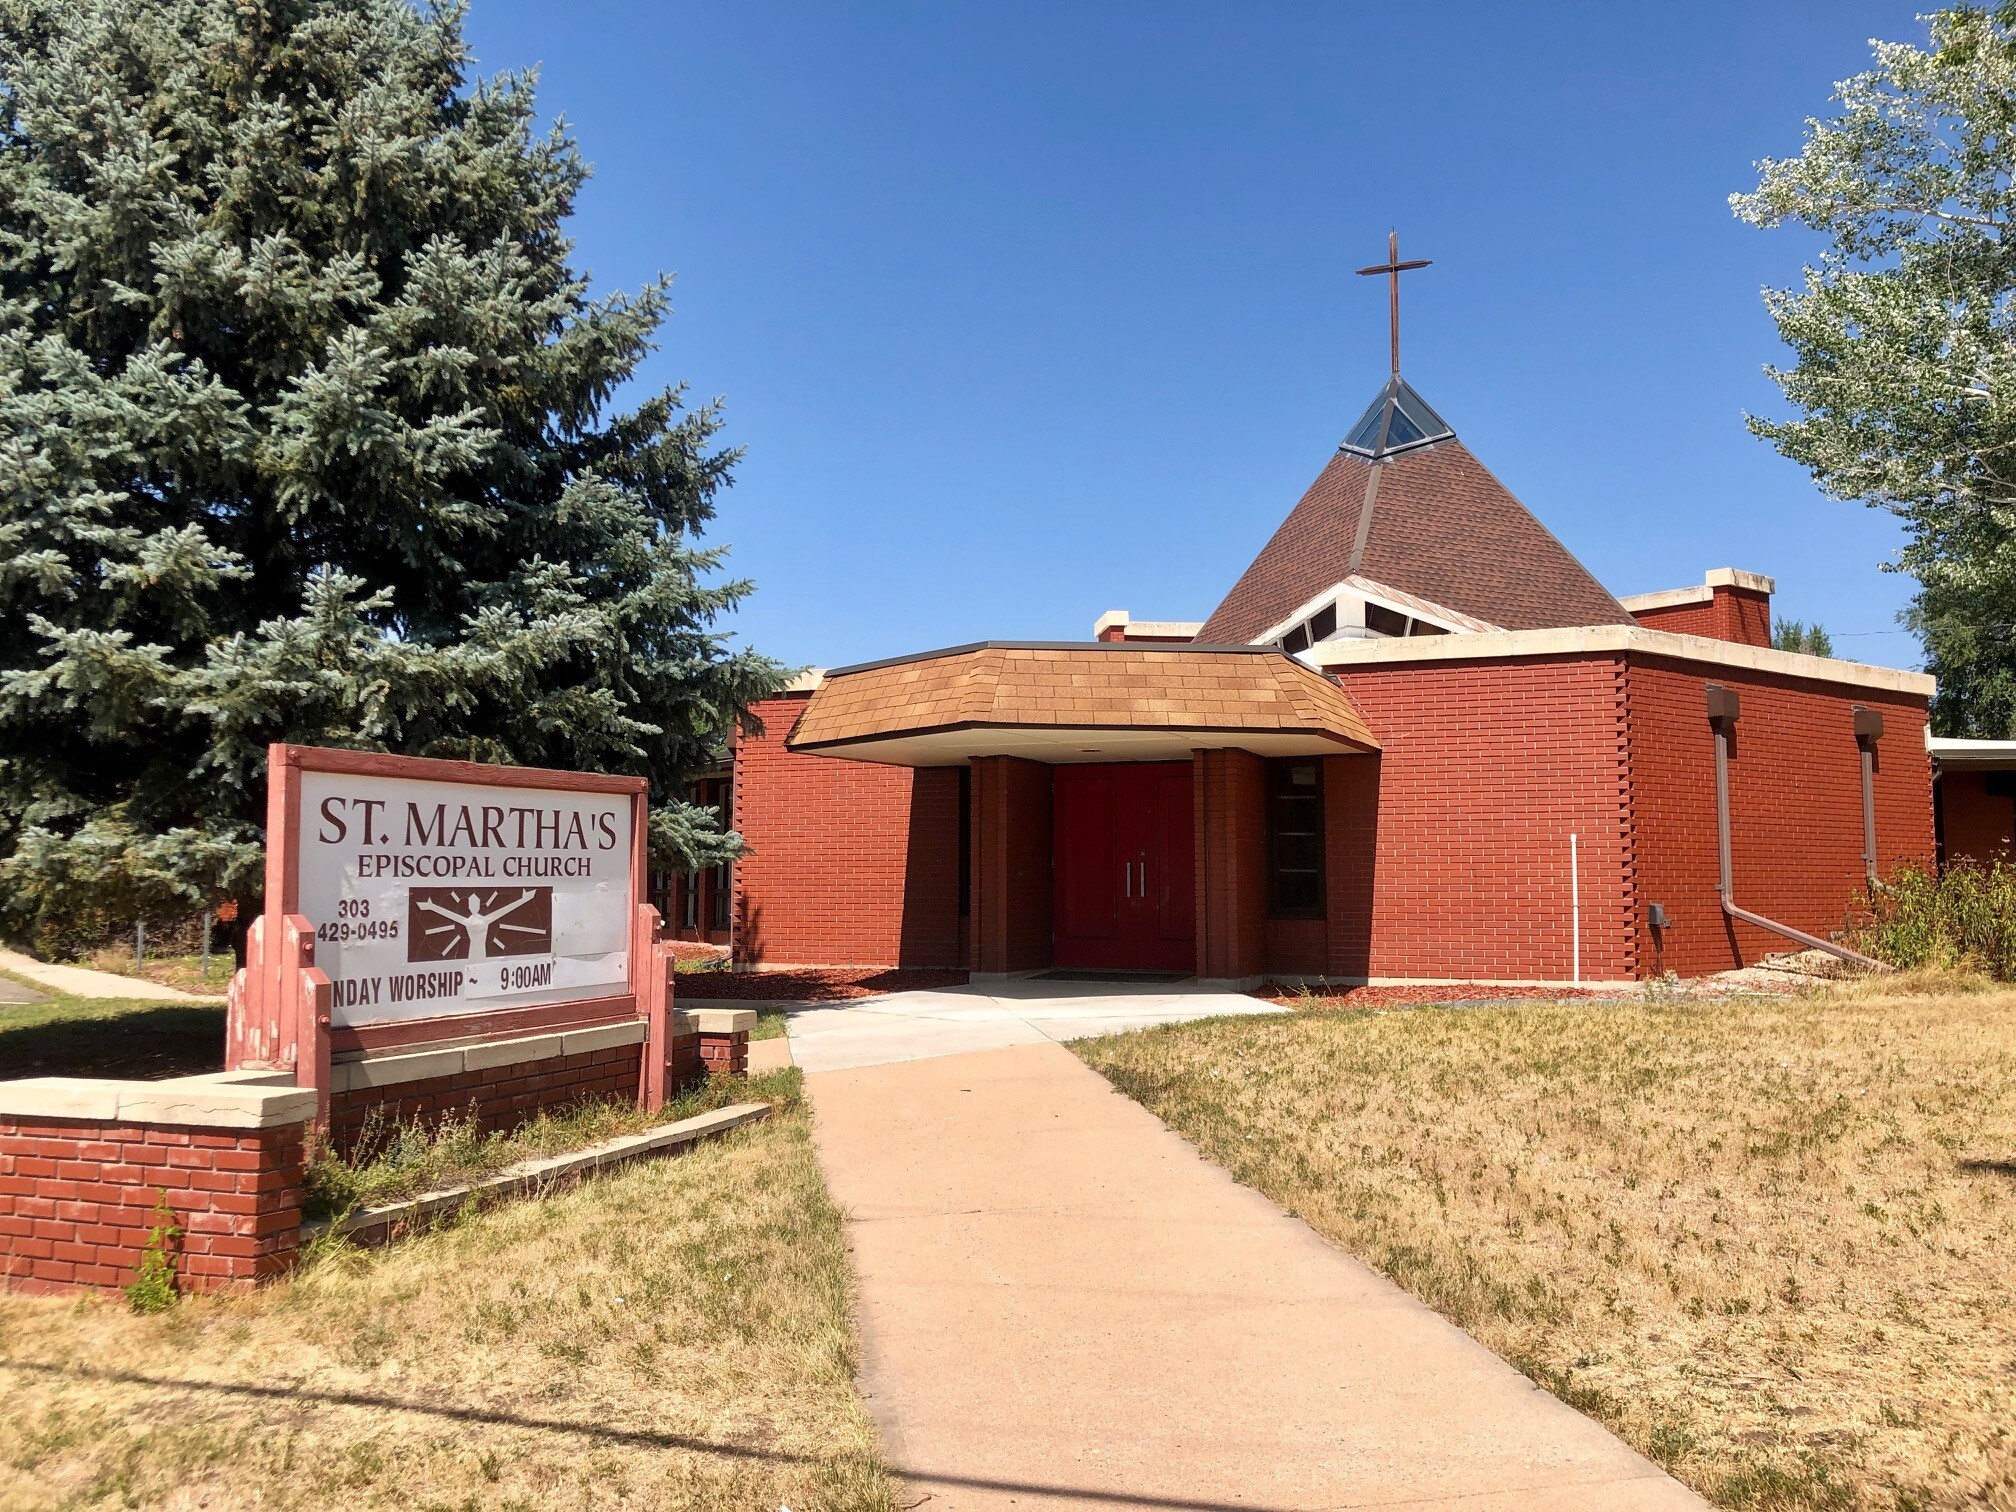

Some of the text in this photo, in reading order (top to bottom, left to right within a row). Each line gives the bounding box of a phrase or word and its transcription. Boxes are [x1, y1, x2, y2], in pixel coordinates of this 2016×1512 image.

[319, 797, 616, 850] ST. MARTHA'S
[358, 855, 591, 877] EPISCOPAL CHURCH
[338, 899, 369, 918] 303
[318, 921, 398, 942] 429-0495
[333, 977, 381, 1008] NDAY
[389, 971, 463, 1002] WORSHIP
[501, 963, 550, 991] 9:00AM
